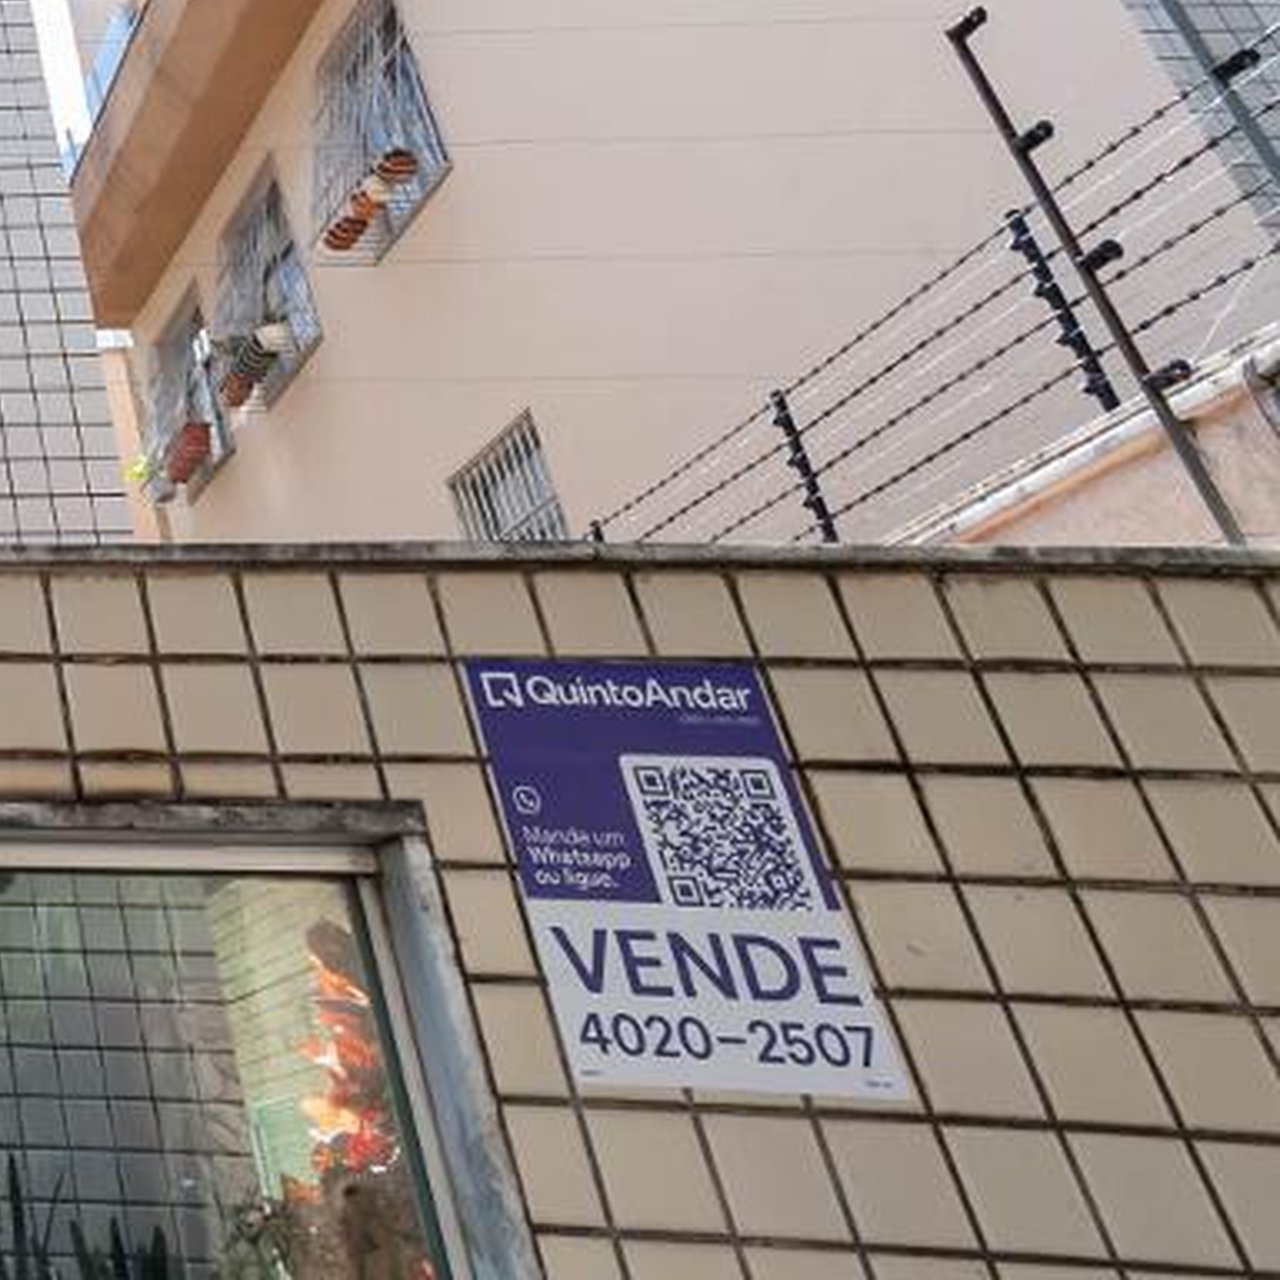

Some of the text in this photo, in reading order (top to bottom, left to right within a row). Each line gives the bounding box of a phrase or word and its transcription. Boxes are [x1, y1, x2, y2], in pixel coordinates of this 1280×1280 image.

[525, 675, 752, 711] QuintoAndar
[522, 825, 624, 845] Mande um
[535, 869, 560, 884] ou
[550, 926, 863, 1007] VENDE
[579, 1012, 876, 1069] 4020-2507
